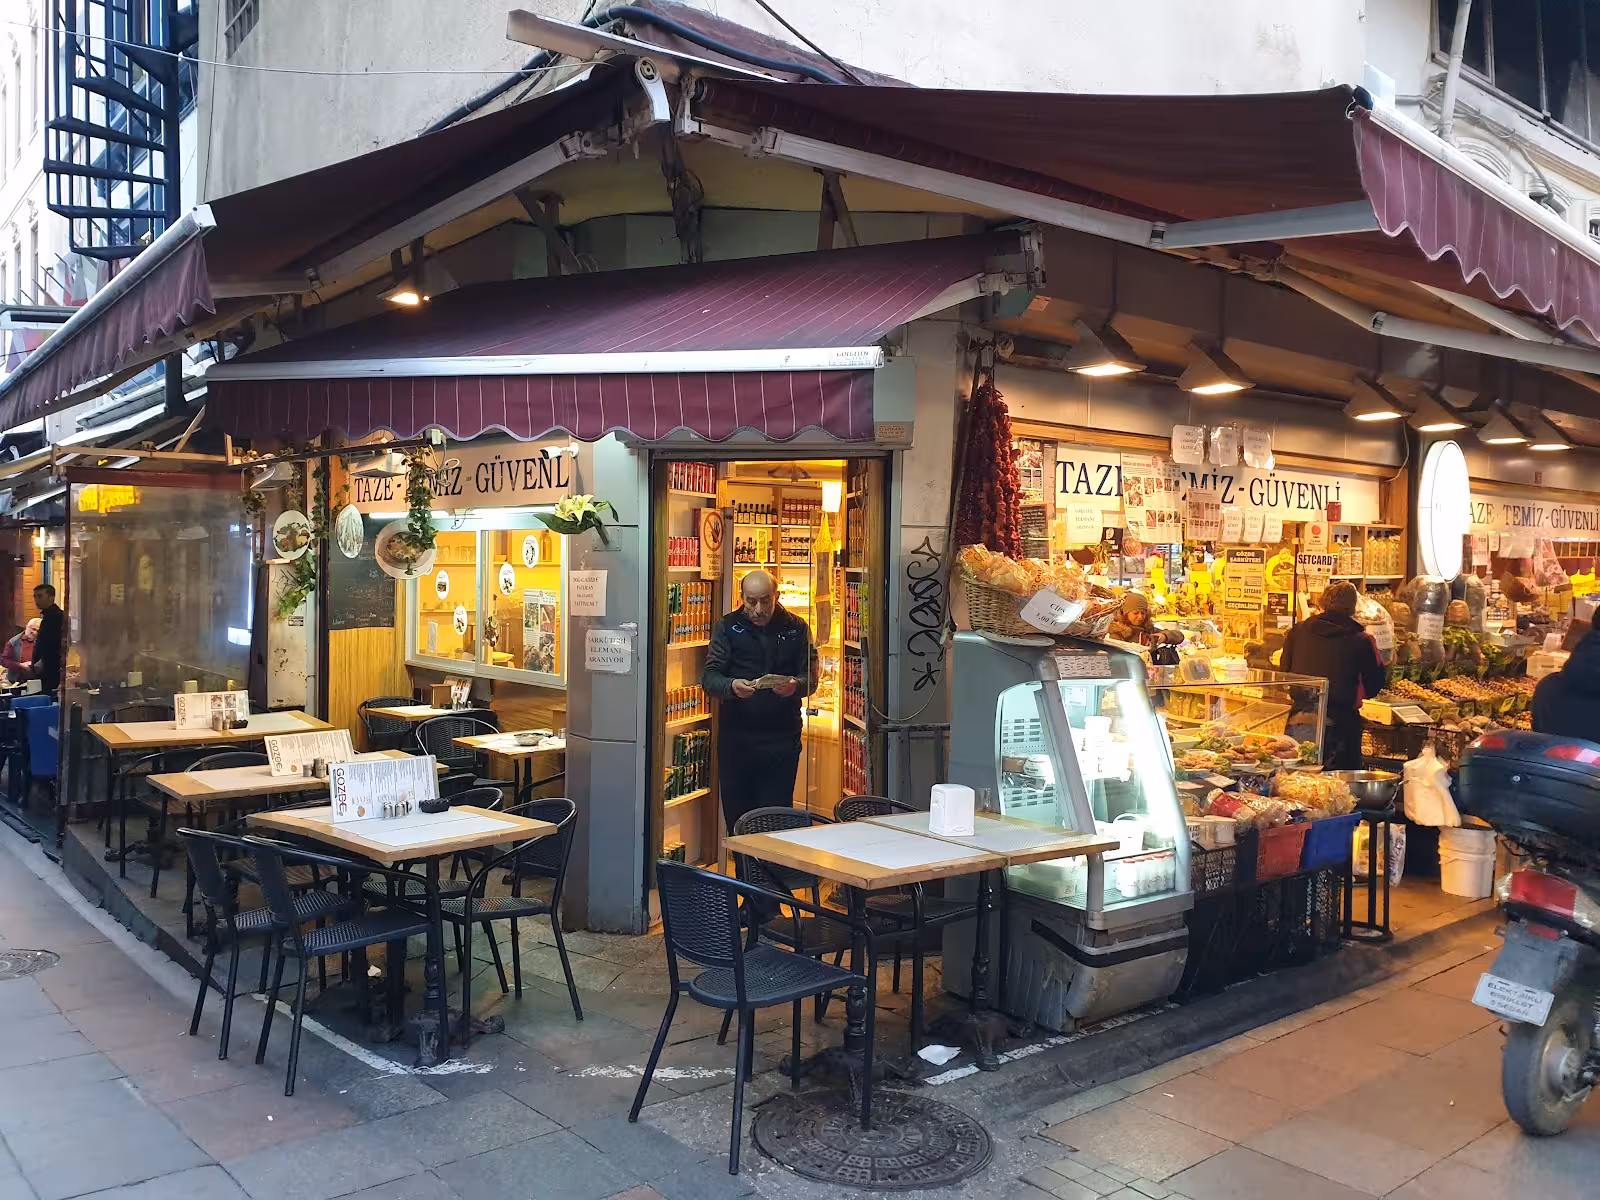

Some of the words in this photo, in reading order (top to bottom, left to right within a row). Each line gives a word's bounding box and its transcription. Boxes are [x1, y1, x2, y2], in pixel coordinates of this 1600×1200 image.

[1470, 501, 1495, 524] AZE
[1551, 504, 1599, 531] GÜVENLİ
[1298, 554, 1333, 566] SETCARD
